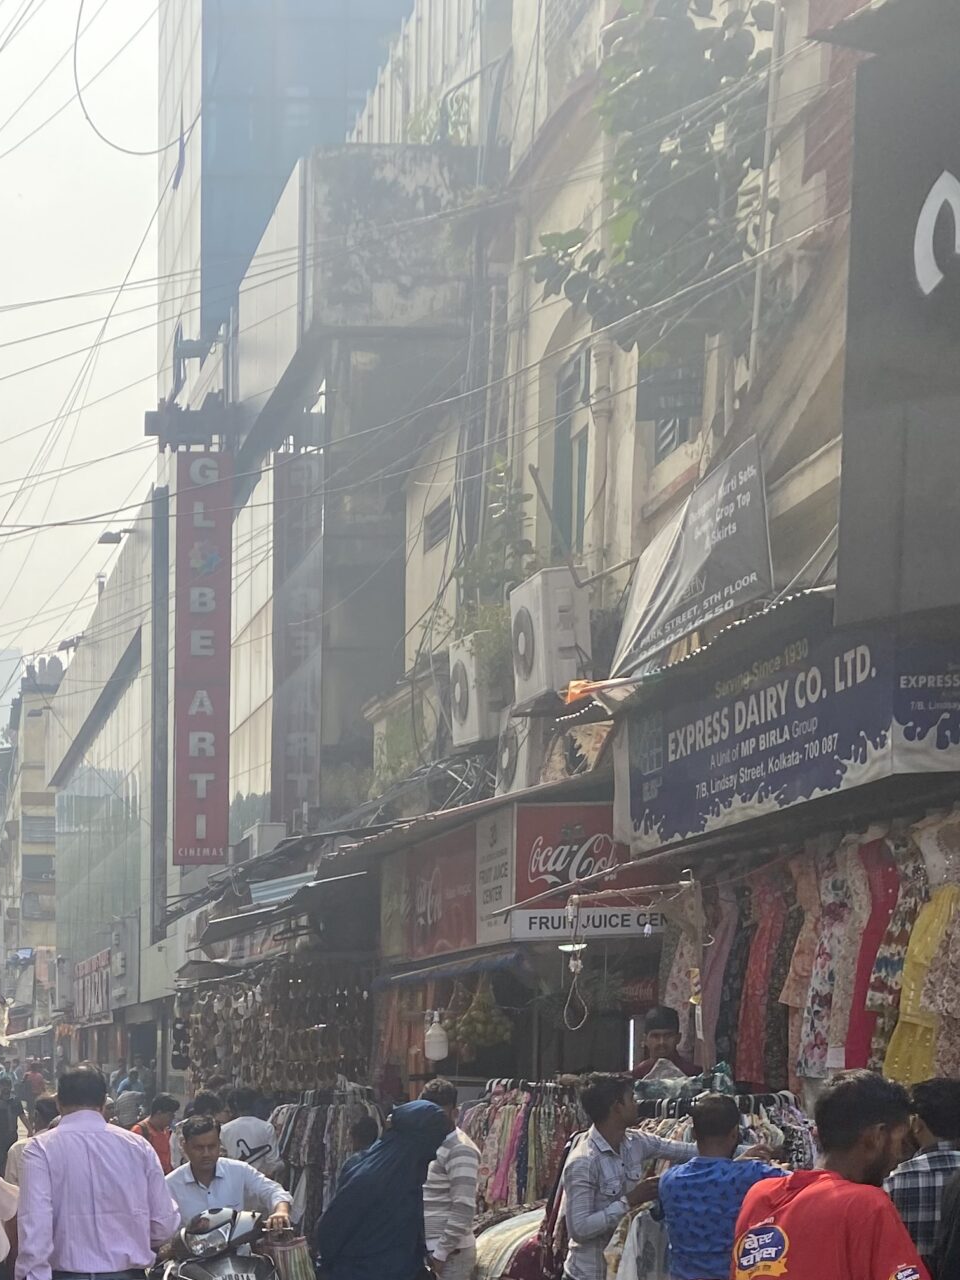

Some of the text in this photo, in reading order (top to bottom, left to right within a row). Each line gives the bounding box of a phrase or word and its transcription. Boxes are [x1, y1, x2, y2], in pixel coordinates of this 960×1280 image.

[736, 490, 751, 509] Top
[723, 571, 758, 597] FLOOR
[899, 674, 960, 689] EXPRESS
[668, 644, 877, 763] EXPRESS DAIRY CO. LTD.
[741, 737, 756, 757] MP
[758, 724, 790, 751] BIRLA
[791, 716, 818, 738] Group
[188, 689, 216, 840] ARTI
[710, 774, 738, 795] Lindsay
[803, 739, 820, 760] 700
[821, 732, 839, 754] 087
[178, 847, 224, 857] CINEMAS
[528, 833, 619, 883] Coca-Col
[528, 915, 578, 931] FRUIT
[582, 913, 632, 930] JUICE
